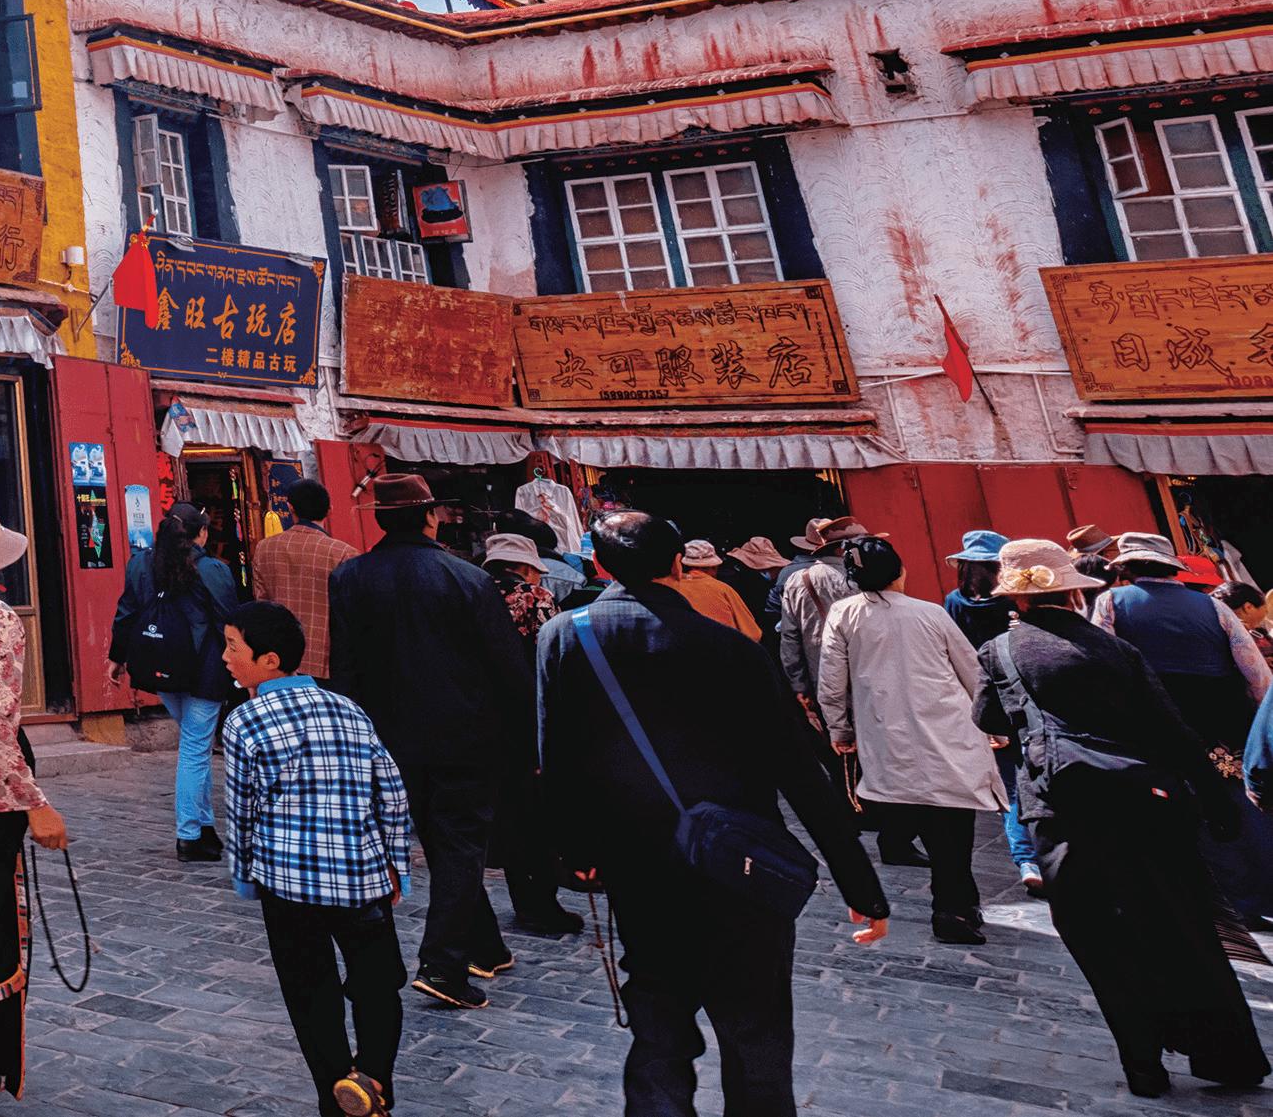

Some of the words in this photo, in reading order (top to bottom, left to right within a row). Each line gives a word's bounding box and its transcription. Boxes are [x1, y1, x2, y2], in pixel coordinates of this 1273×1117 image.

[155, 287, 298, 346] 鑫旺古玩店
[206, 347, 297, 373] 二楼精品古玩
